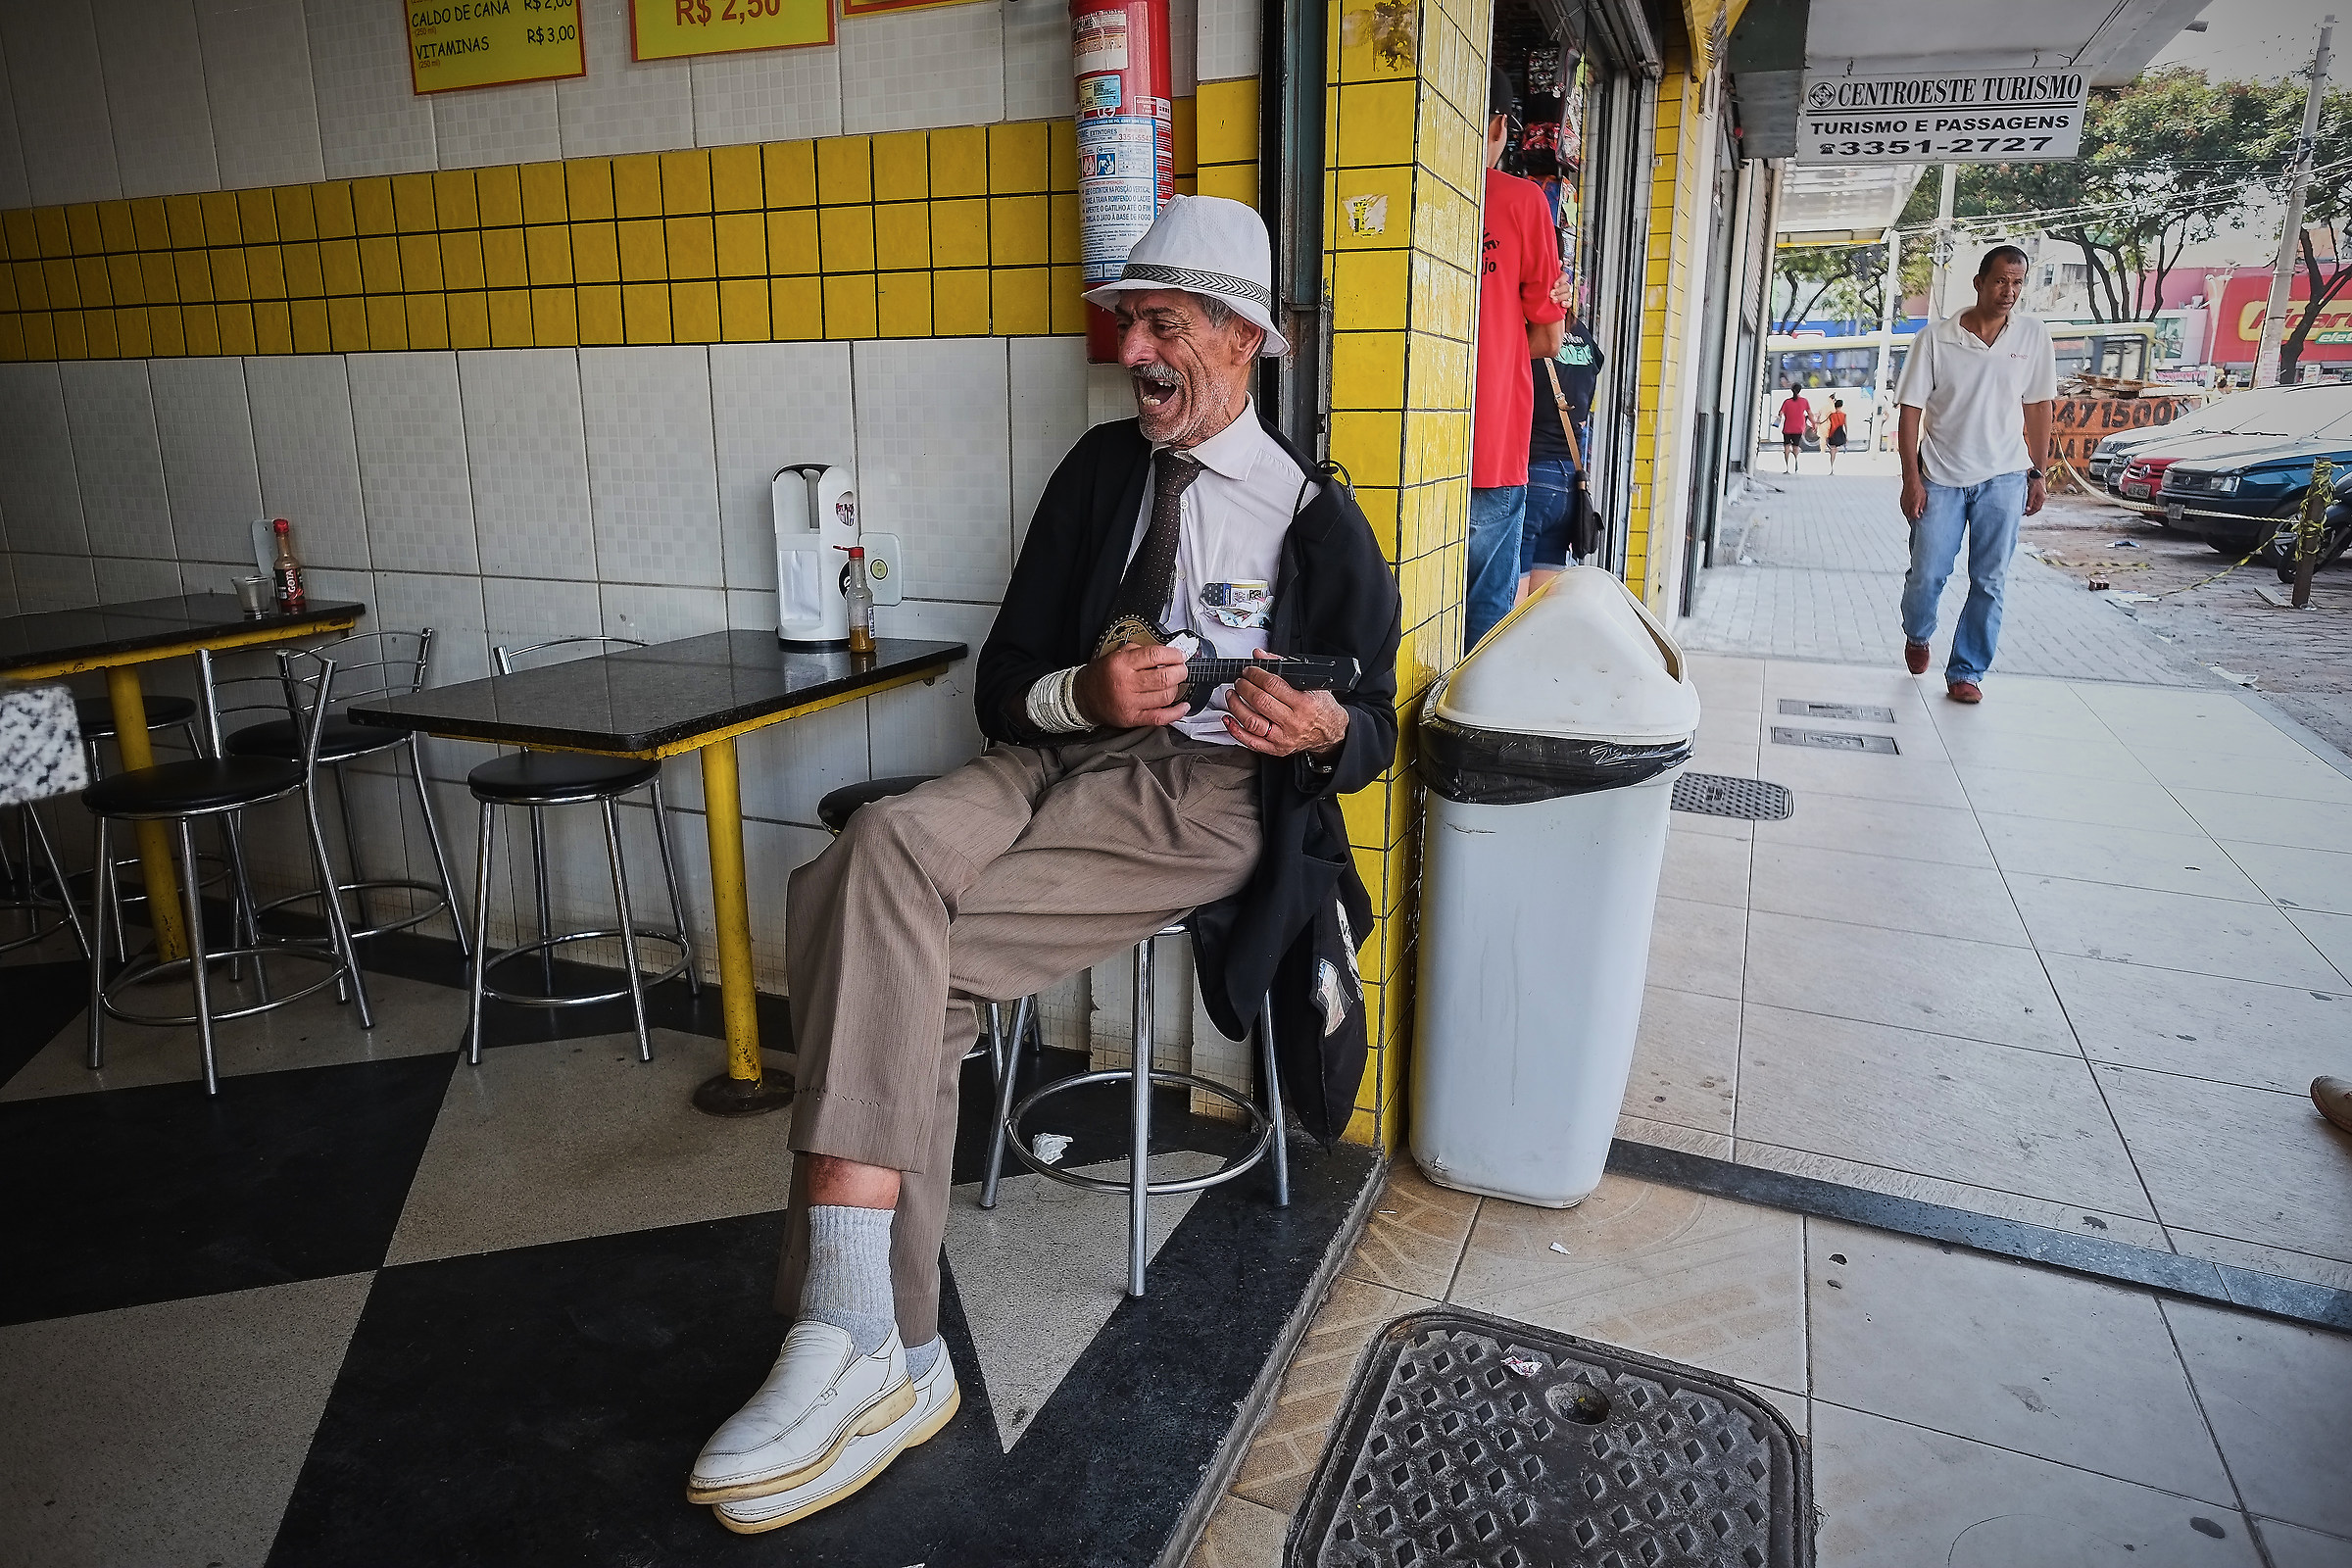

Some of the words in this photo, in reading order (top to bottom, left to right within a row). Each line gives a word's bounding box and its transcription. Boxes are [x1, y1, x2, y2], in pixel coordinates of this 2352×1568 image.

[412, 8, 451, 27] CALDO
[455, 4, 471, 22] DE
[474, 2, 511, 18] CANA
[674, 0, 712, 26] R$
[527, 26, 544, 45] R$
[547, 24, 575, 44] 3,00
[415, 36, 490, 60] VITAMINAS
[1838, 78, 1976, 107] CENTROESTE
[1983, 74, 2082, 101] TURISMO
[1811, 120, 1907, 135] TURISMO
[1915, 119, 1928, 131] E
[1936, 116, 2070, 131] PASSAGENS
[1838, 136, 2053, 156] 3351-2727
[286, 569, 296, 593] GOTA
